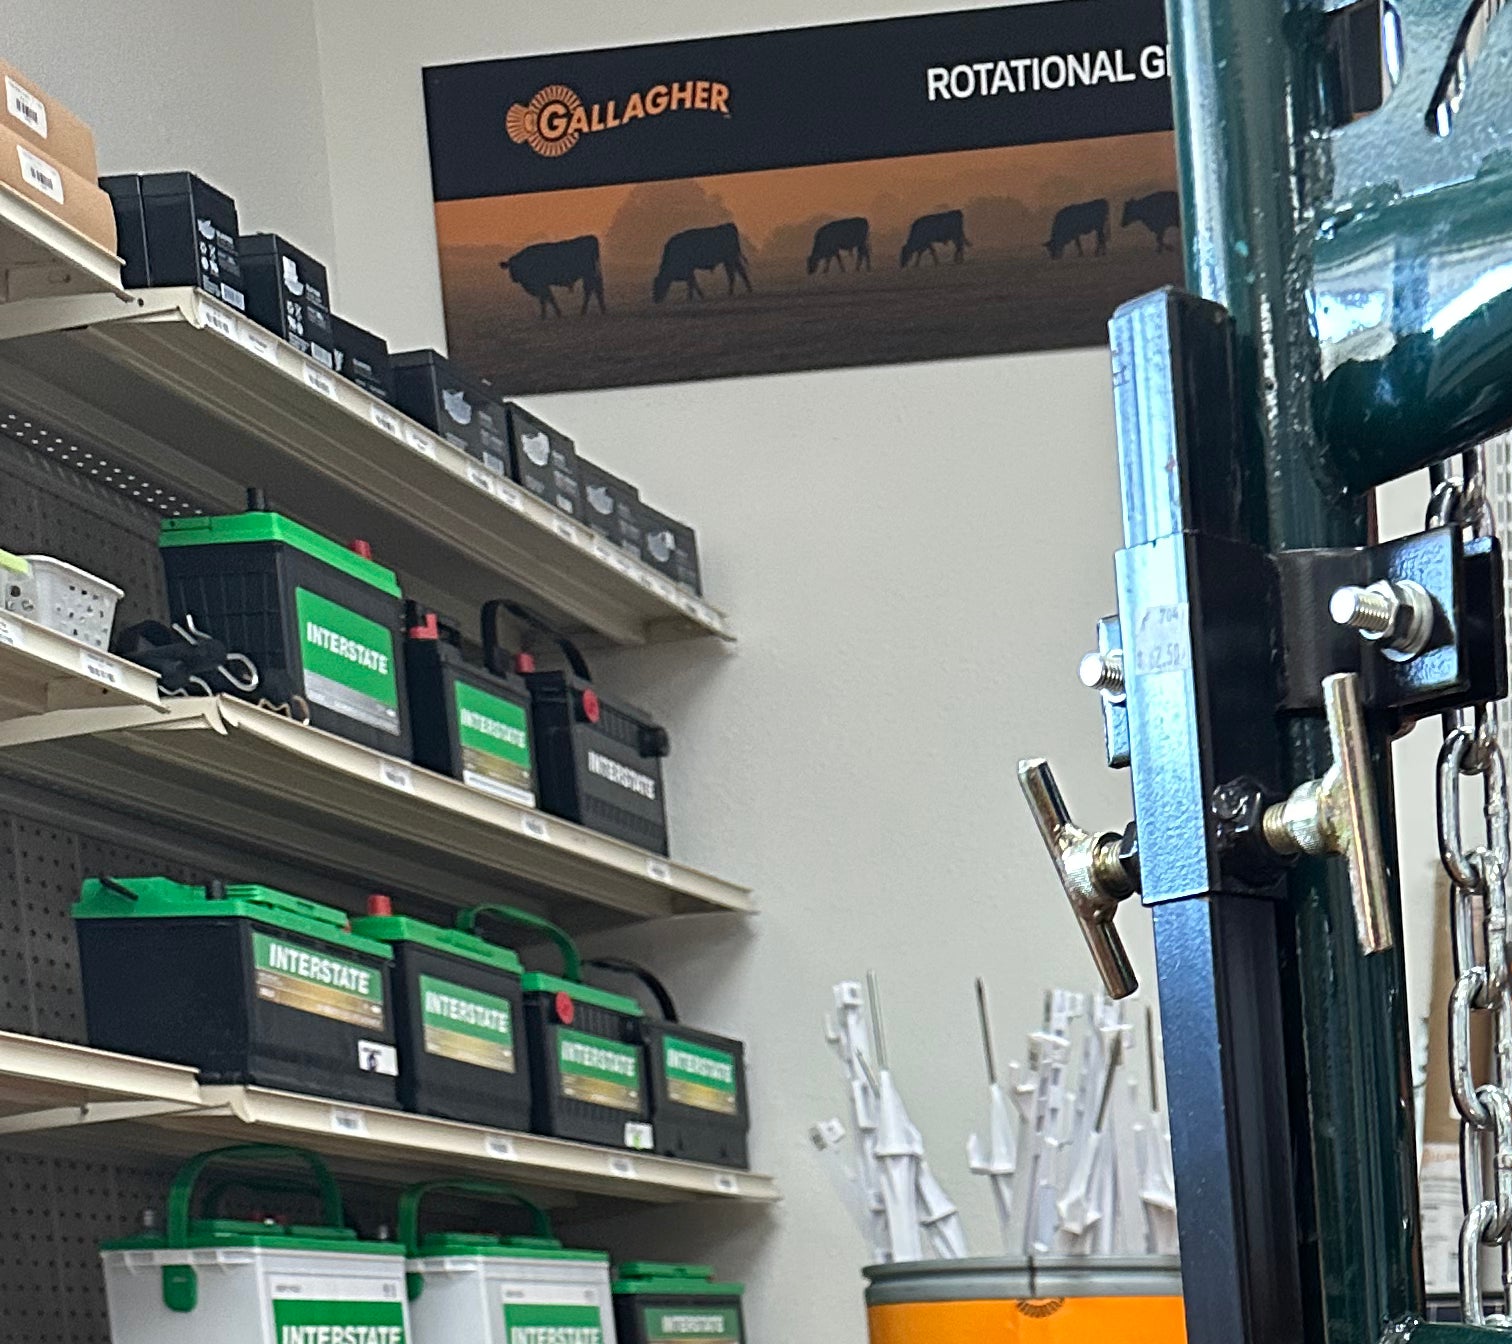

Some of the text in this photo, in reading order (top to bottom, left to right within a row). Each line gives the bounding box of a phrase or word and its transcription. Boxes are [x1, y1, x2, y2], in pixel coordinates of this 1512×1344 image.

[926, 45, 1171, 101] ROTATIONAL G
[537, 80, 731, 142] GALLAGHER
[306, 621, 389, 675] INTERSTATE
[459, 706, 527, 750] INTERSTATE
[588, 750, 656, 799] INTERSTATE
[269, 943, 370, 995] INTERSTATE
[424, 991, 509, 1034] INTERSTATE
[560, 1039, 637, 1078] INTERSTATE
[666, 1046, 734, 1084] INTERSTATE
[661, 1315, 724, 1333] INTERSTATE
